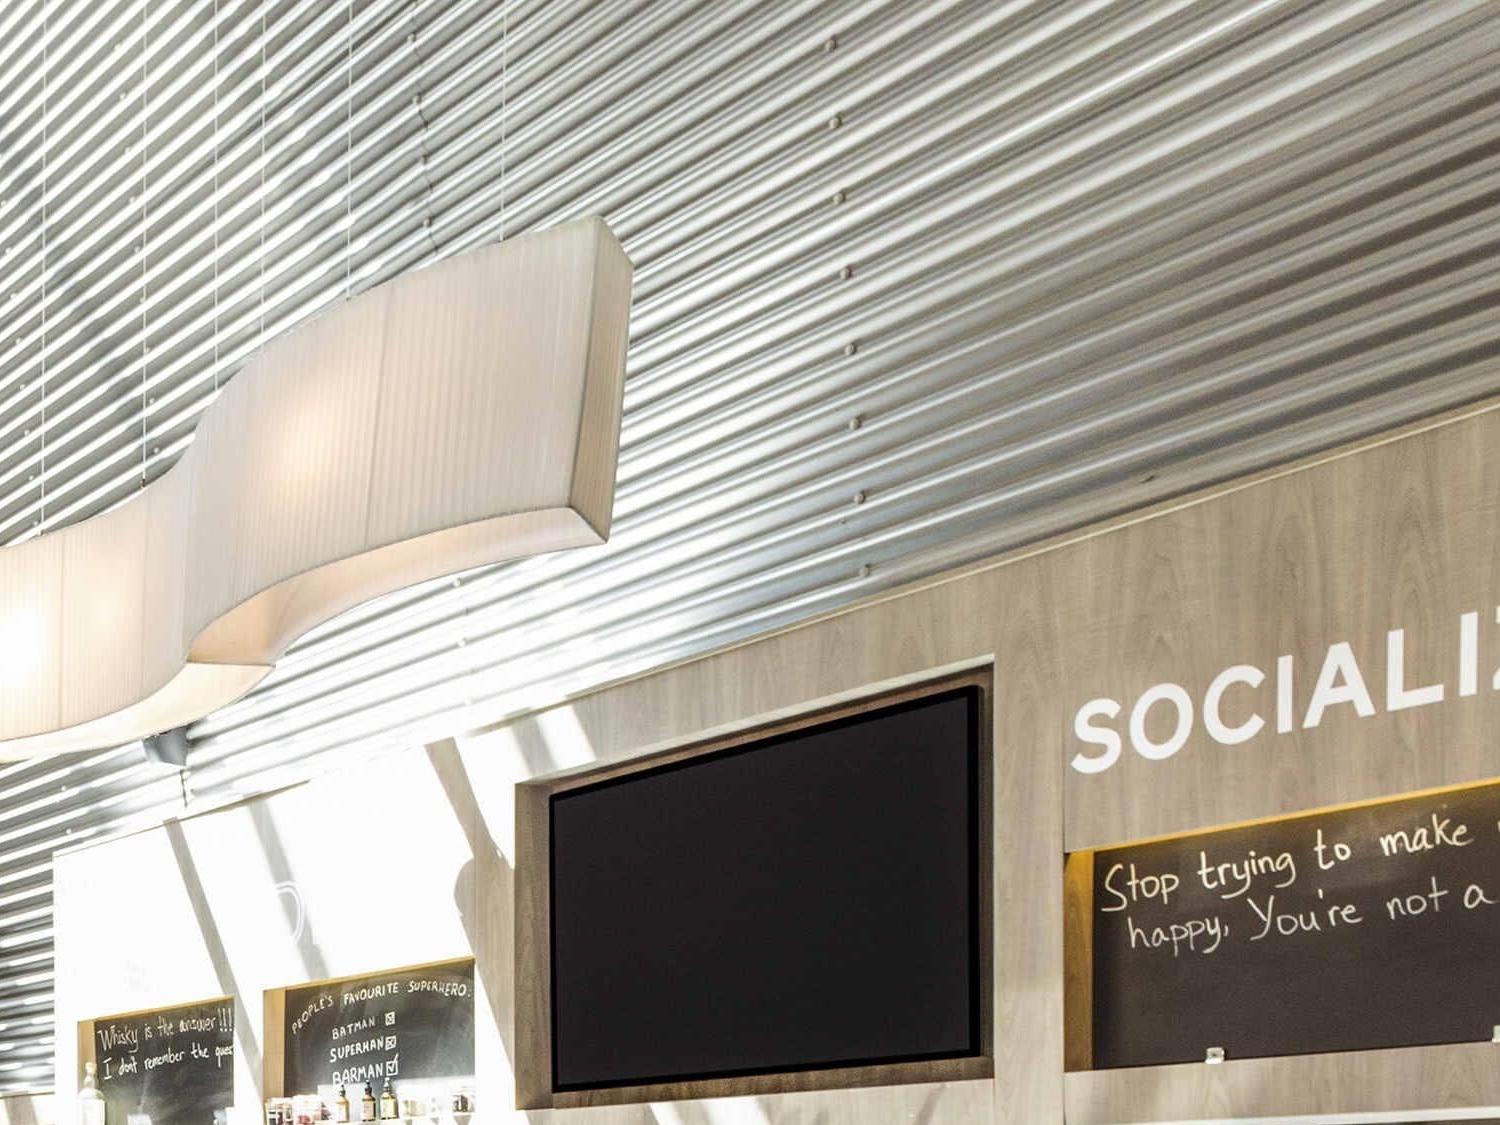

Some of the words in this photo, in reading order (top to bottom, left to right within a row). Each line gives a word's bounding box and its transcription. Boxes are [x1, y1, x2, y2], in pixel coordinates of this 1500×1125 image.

[1070, 605, 1500, 775] SOCIALI
[1101, 863, 1180, 912] Stop
[1197, 850, 1296, 899] trying
[1313, 828, 1351, 870] to
[1379, 812, 1474, 857] make
[1127, 915, 1229, 958] happy,
[1246, 888, 1363, 941] You're
[1386, 875, 1449, 920] not
[1463, 884, 1500, 909] a
[291, 992, 334, 1036] PEOPLE'S
[343, 981, 399, 1006] FAVOURITE
[331, 1015, 376, 1041] BATMAN
[97, 1024, 139, 1054] Whisky
[144, 1023, 153, 1041] is
[157, 1015, 174, 1037] the
[102, 1056, 113, 1081] I
[143, 1047, 185, 1071] remember
[190, 1041, 210, 1059] the
[332, 1062, 383, 1090] BARMAN
